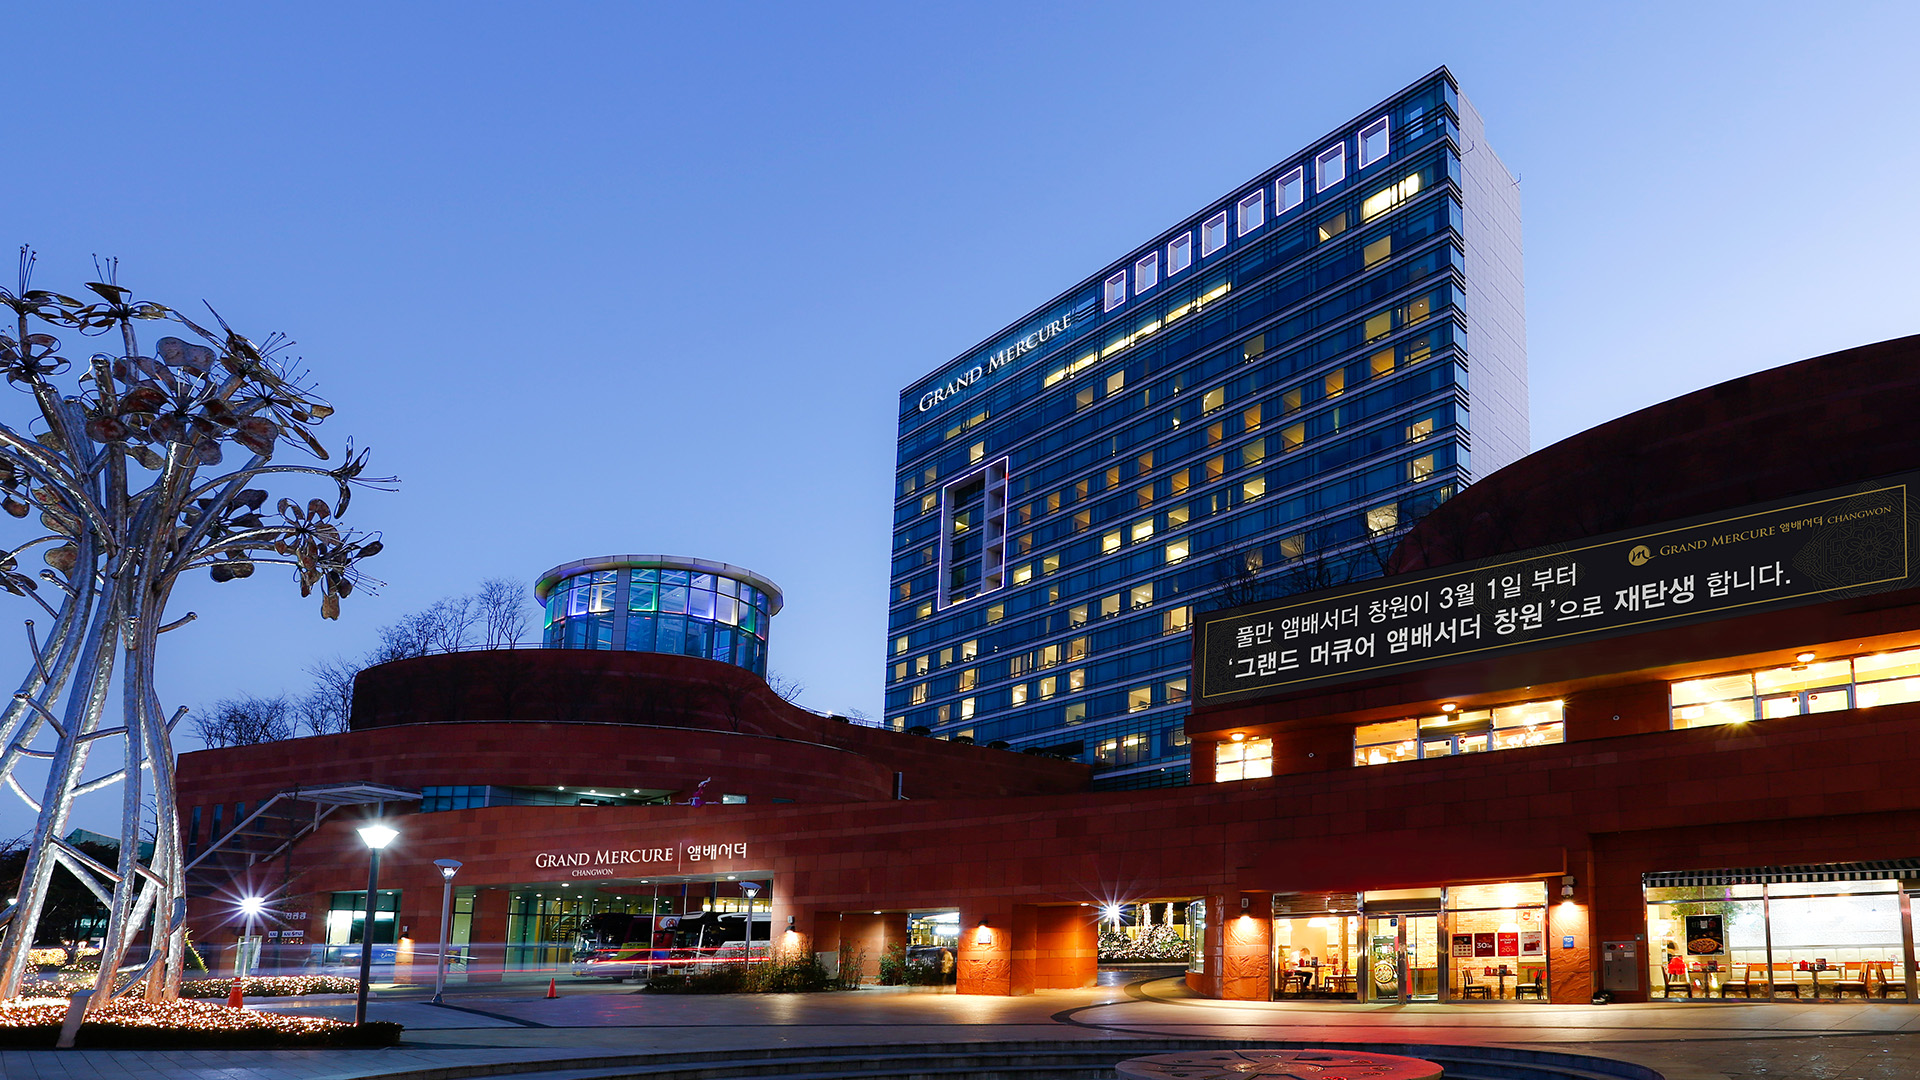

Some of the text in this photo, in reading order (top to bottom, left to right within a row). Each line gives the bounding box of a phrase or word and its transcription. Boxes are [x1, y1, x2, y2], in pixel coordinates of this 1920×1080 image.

[919, 312, 1072, 412] GRAND MERCURE
[1659, 539, 1707, 557] GRAND
[1711, 526, 1776, 548] MERCURE
[1779, 515, 1823, 532] 앰배서더
[1827, 505, 1892, 525] CHANGWON
[1236, 562, 1577, 649] 풀만 앰배서더 창원이 3월 1일 부터
[1310, 634, 1375, 666] 머큐어
[1387, 614, 1481, 654] 앰배서더
[1614, 574, 1695, 612] 재탄생
[1706, 561, 1791, 598] 합니다.
[535, 842, 747, 868] GRAND MERCURE 앰배서더
[572, 868, 613, 877] CHANGWON
